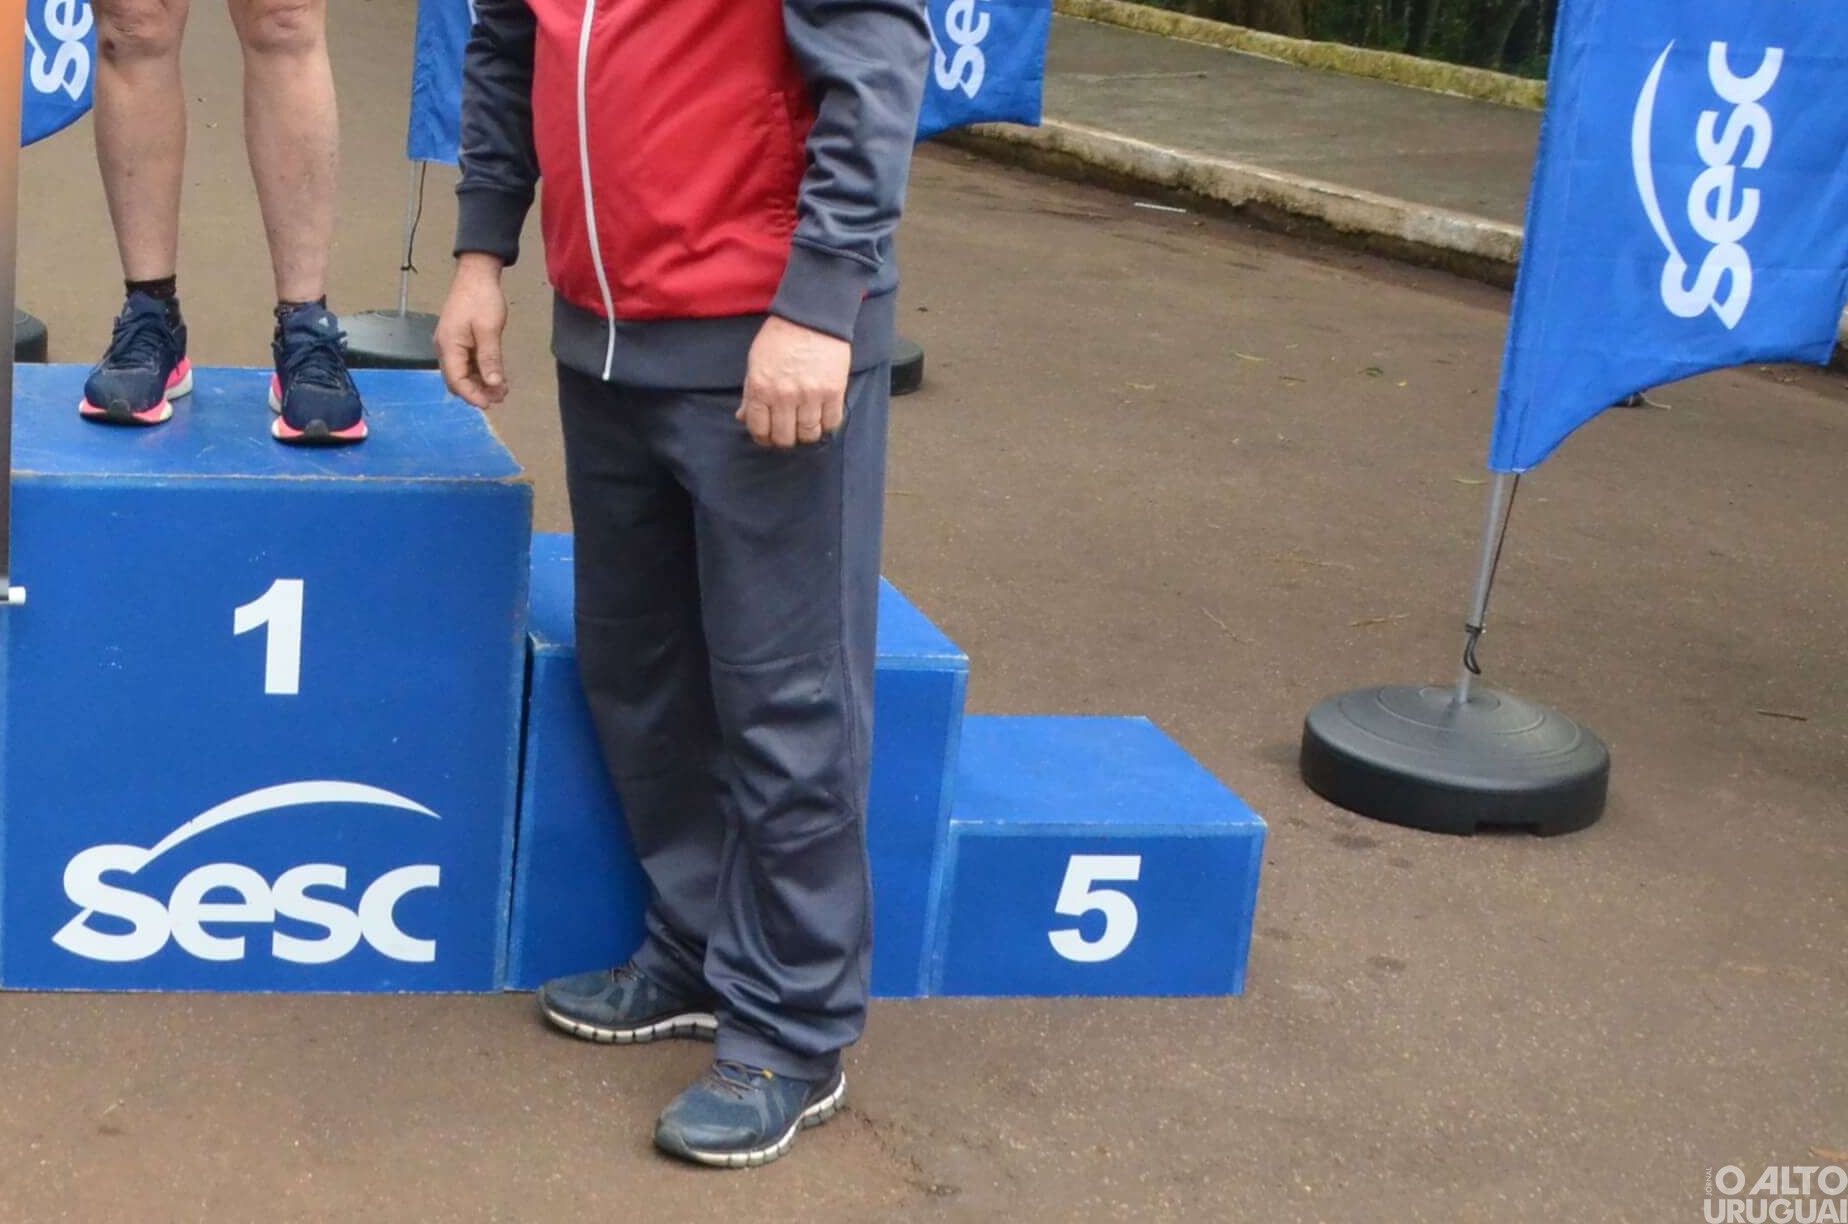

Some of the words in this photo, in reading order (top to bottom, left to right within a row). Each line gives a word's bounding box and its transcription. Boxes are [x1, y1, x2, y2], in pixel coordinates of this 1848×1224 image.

[1661, 41, 1784, 330] Sesc
[233, 578, 304, 695] 1
[51, 842, 441, 964] Sesc
[1047, 854, 1142, 963] 5
